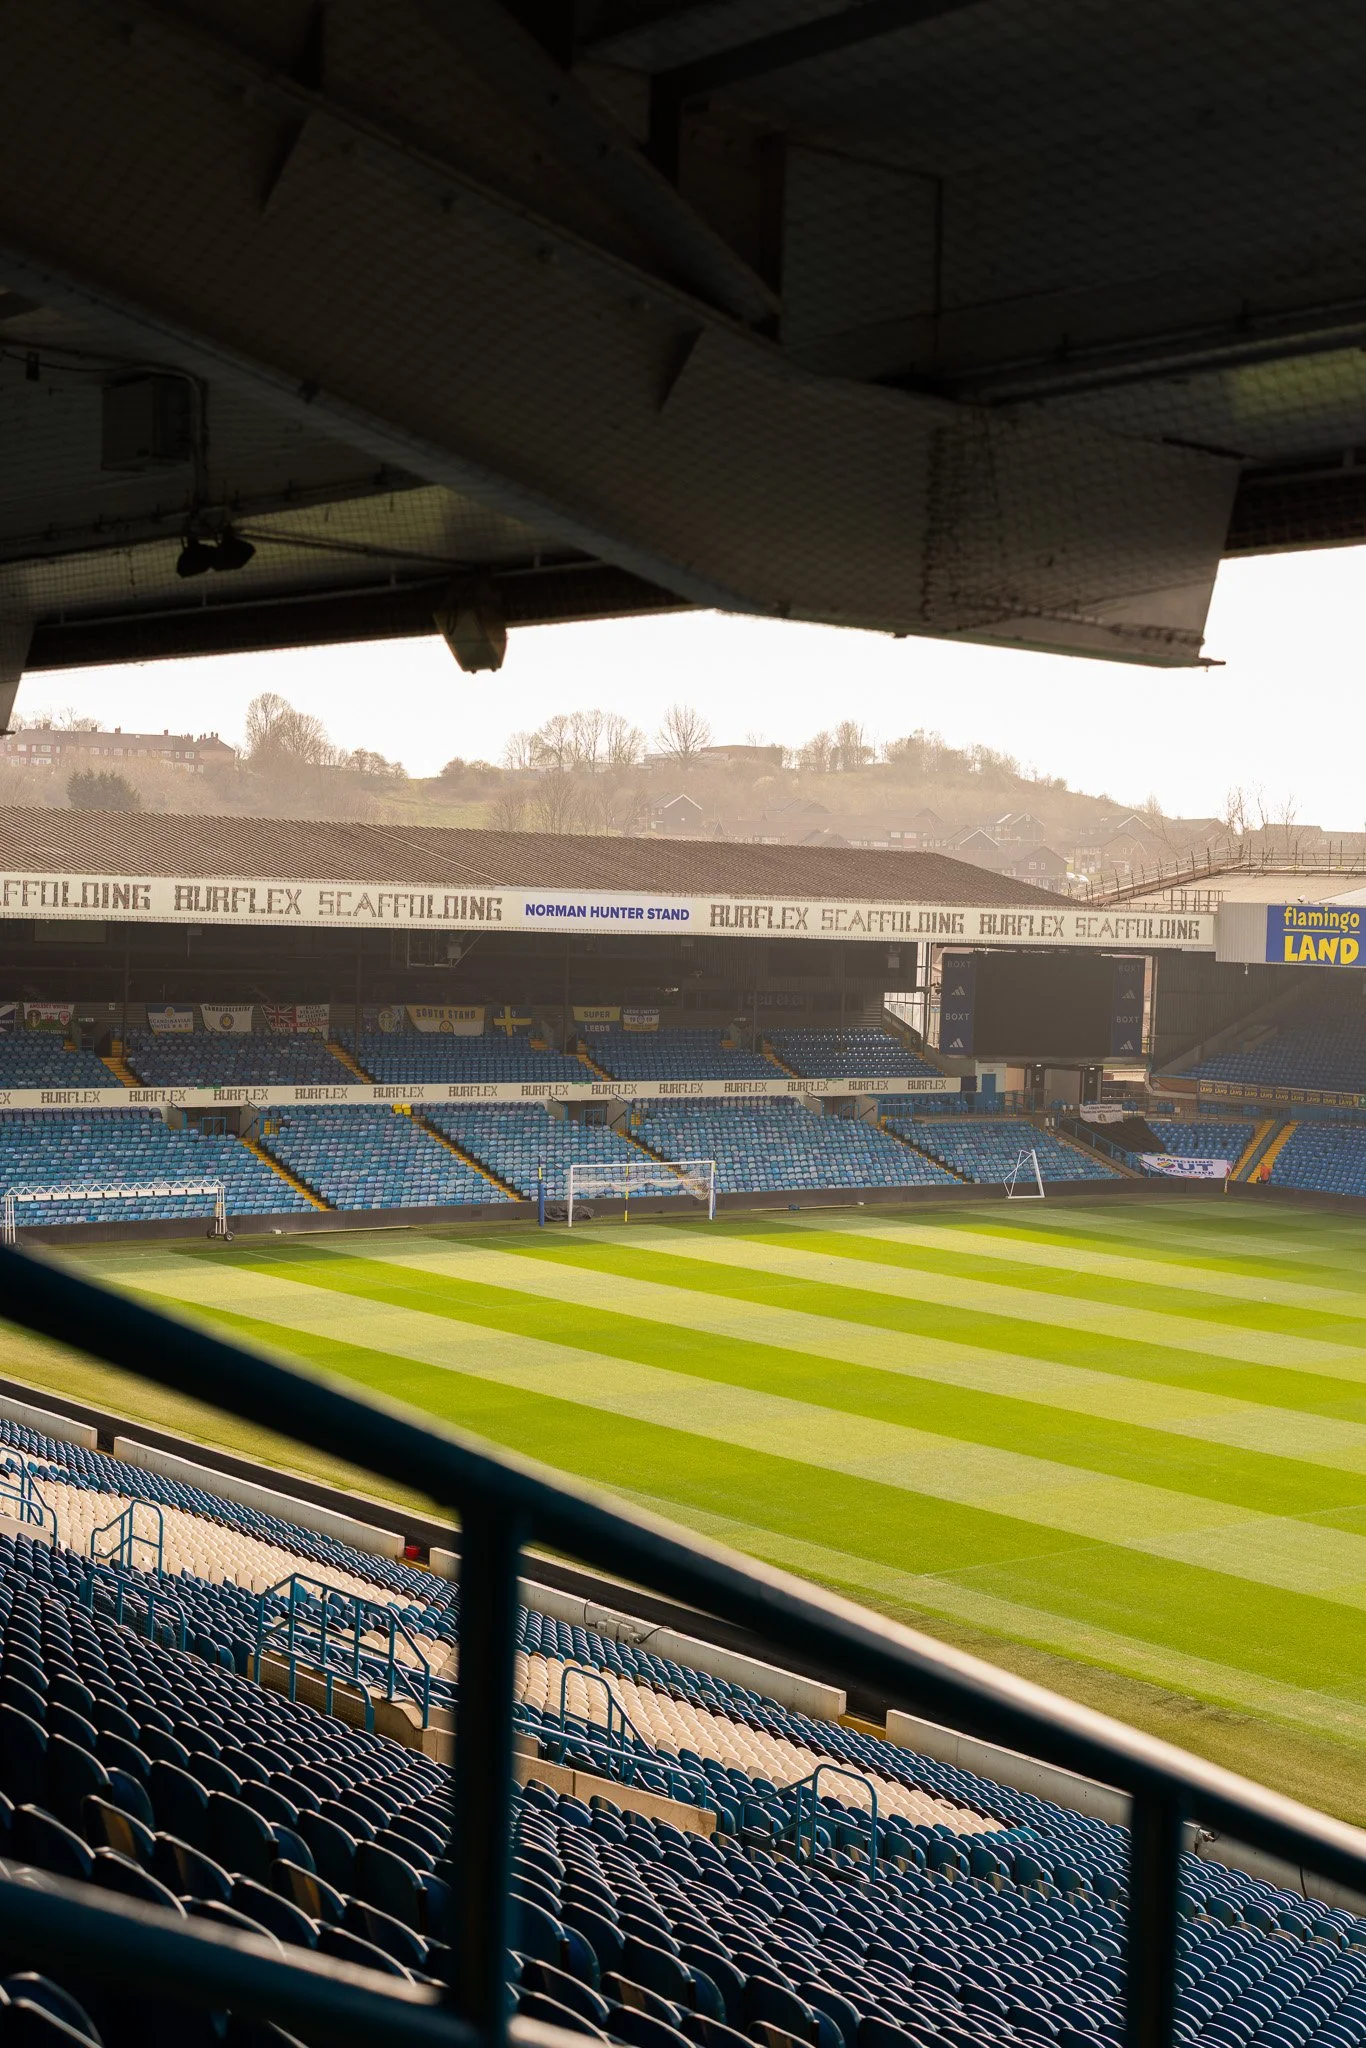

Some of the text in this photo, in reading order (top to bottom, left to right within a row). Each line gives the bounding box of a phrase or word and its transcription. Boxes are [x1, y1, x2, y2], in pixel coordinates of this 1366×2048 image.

[0, 879, 503, 921] FFOLDING BURFLEX SCAFFOLDING
[525, 904, 690, 921] NORMAN HUNTER STAND
[709, 904, 1200, 940] BURFLEX SCAFFOLDING BURFLEX SCAFFOLDING
[1284, 906, 1360, 933] flamingo
[1284, 934, 1360, 965] LAND
[947, 960, 971, 968] BOXT
[415, 1008, 476, 1020] SOUTH STAND
[945, 1013, 970, 1021] BOXT
[584, 1024, 610, 1032] LEEDS
[41, 1079, 946, 1104] BURFLEX BURFLEX BURFLEX BURFLEX BURFLEX BURFLEX BURFLEX BURFLEX BURFLEX BURFLEX BURFLEX BURFLEX BURFLEX
